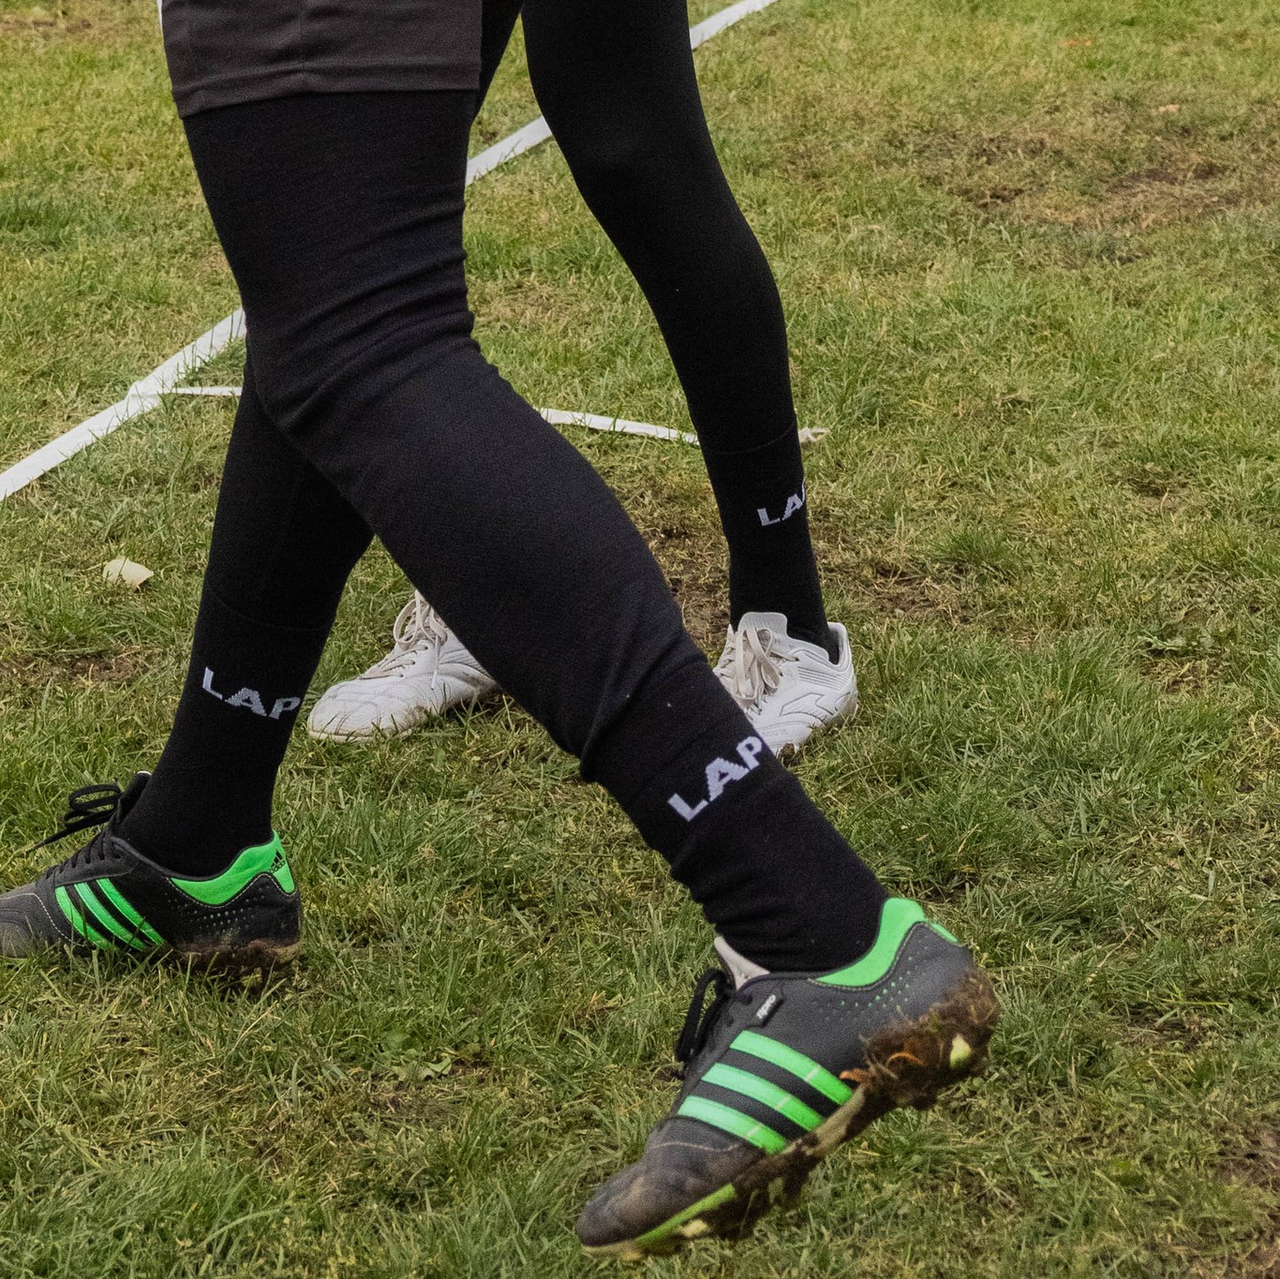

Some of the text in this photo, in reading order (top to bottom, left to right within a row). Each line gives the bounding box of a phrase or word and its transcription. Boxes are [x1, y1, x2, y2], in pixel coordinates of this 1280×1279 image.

[757, 477, 805, 526] LA
[202, 666, 300, 719] LAP
[667, 736, 762, 821] LAP
